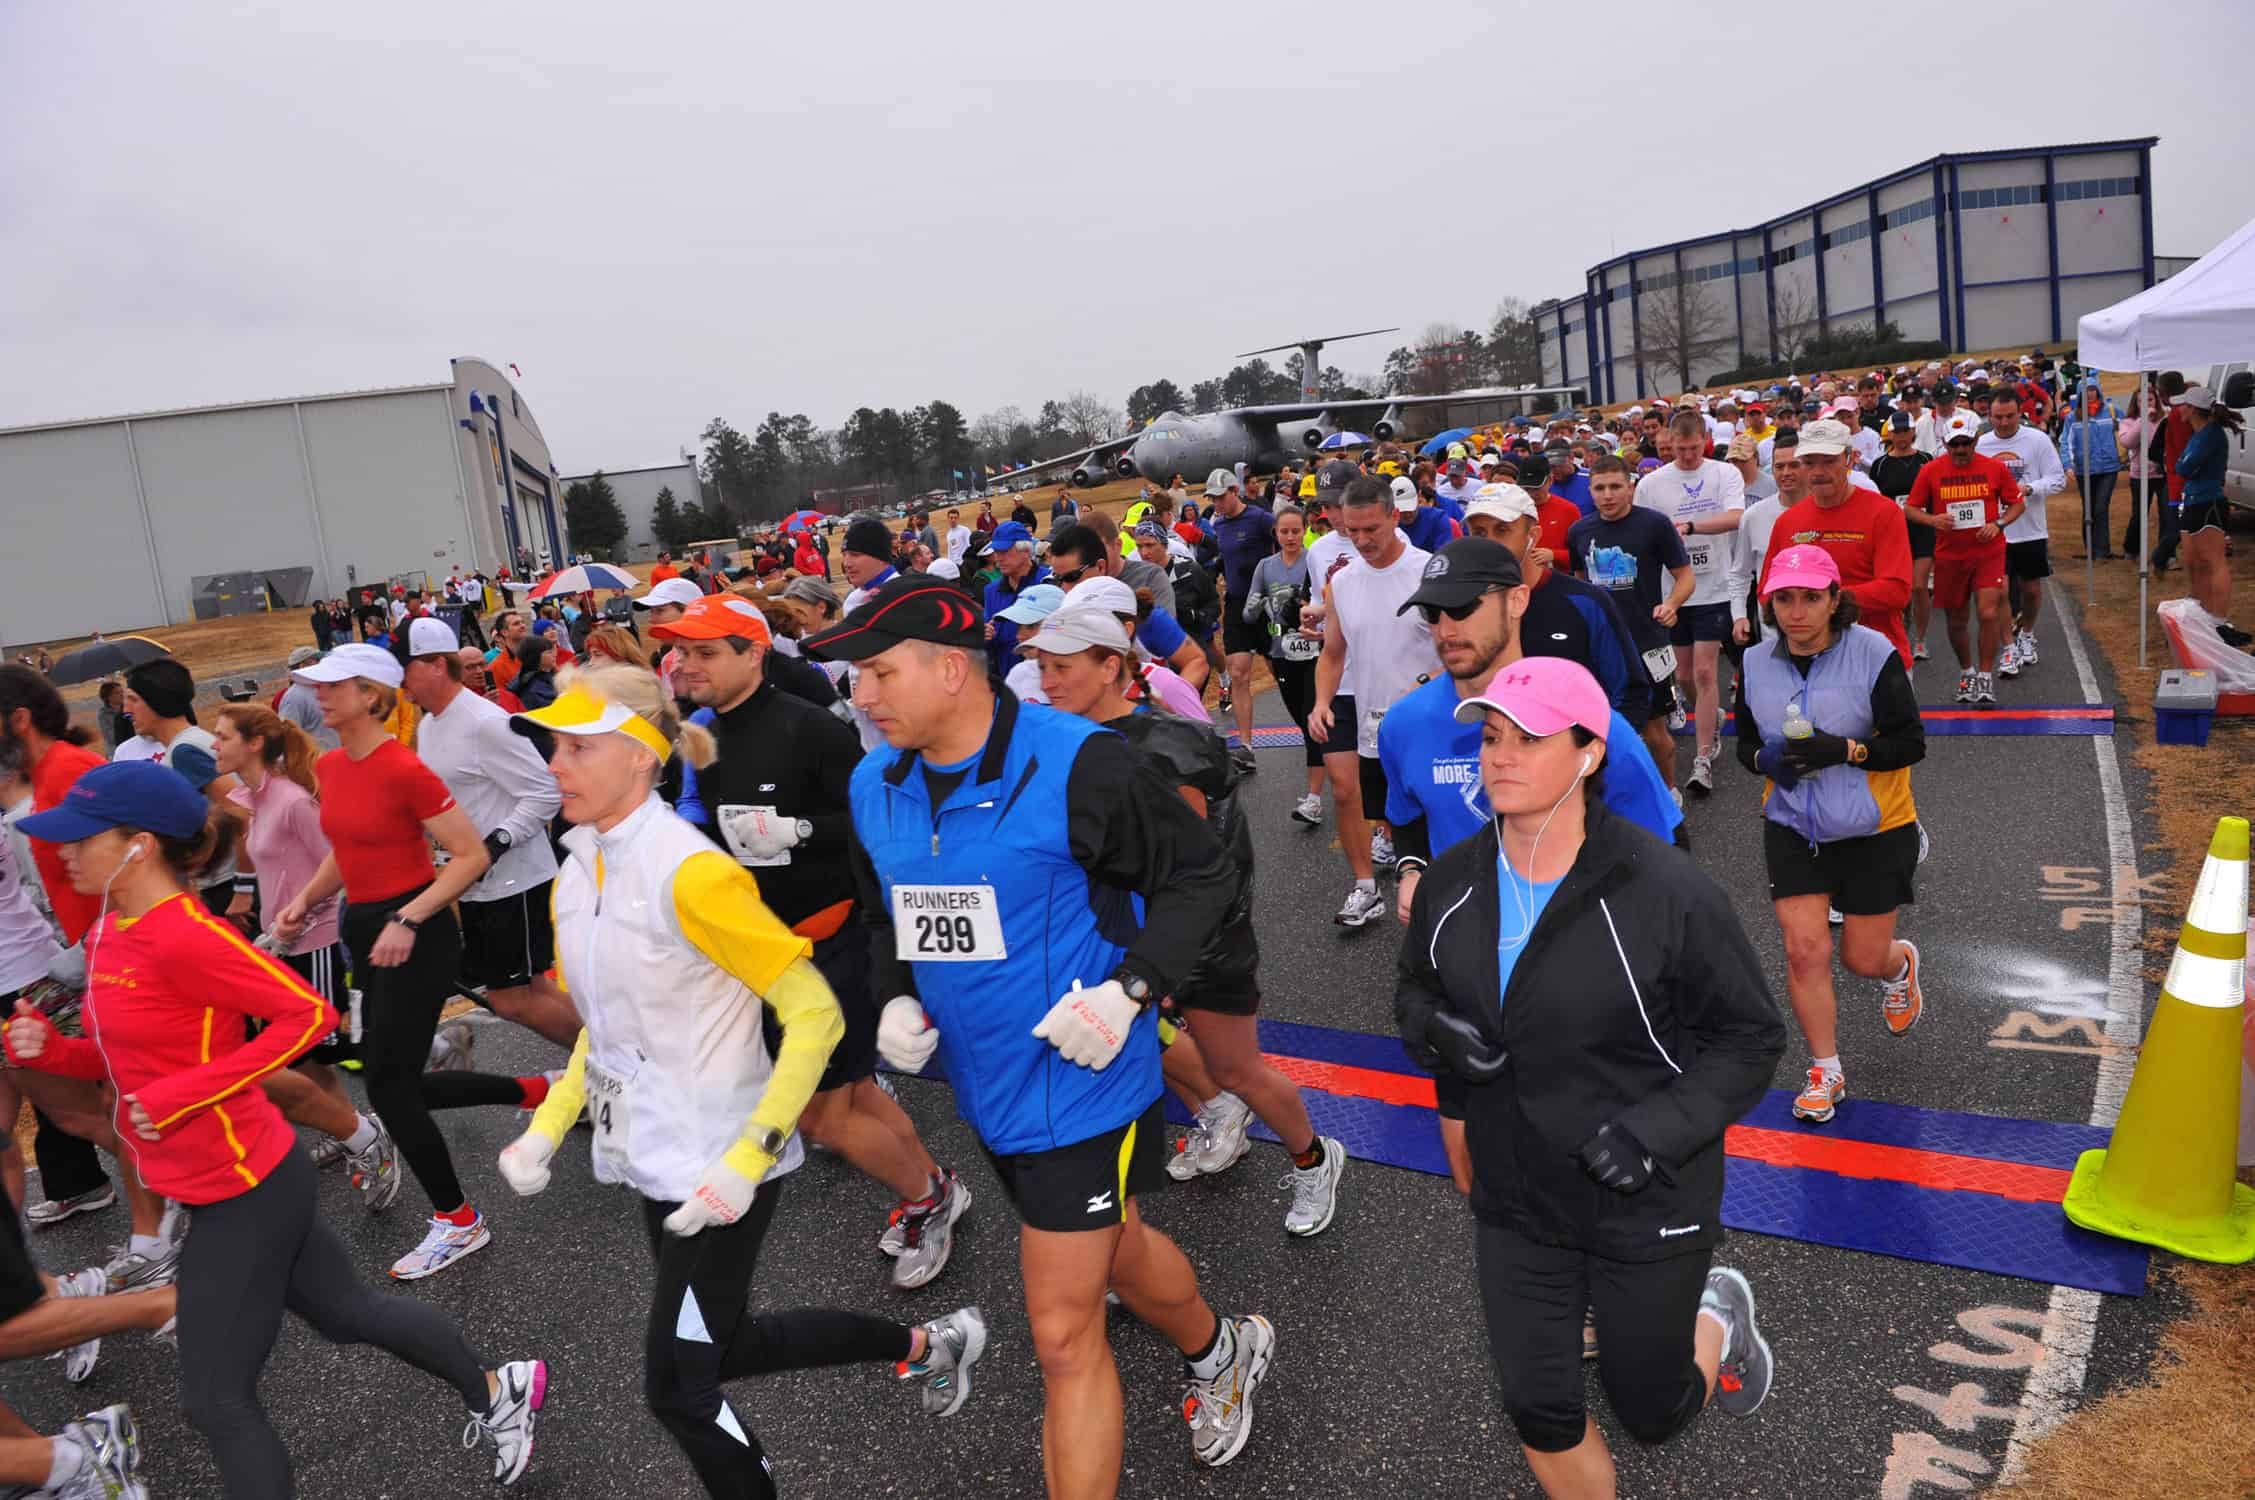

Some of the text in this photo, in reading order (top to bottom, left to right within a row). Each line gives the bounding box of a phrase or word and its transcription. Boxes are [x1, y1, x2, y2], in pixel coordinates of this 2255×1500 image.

[1959, 509, 1973, 520] 99
[1289, 640, 1310, 652] 443
[1433, 764, 1472, 784] MORE
[903, 891, 980, 909] RUNNERS
[916, 915, 976, 953] 299
